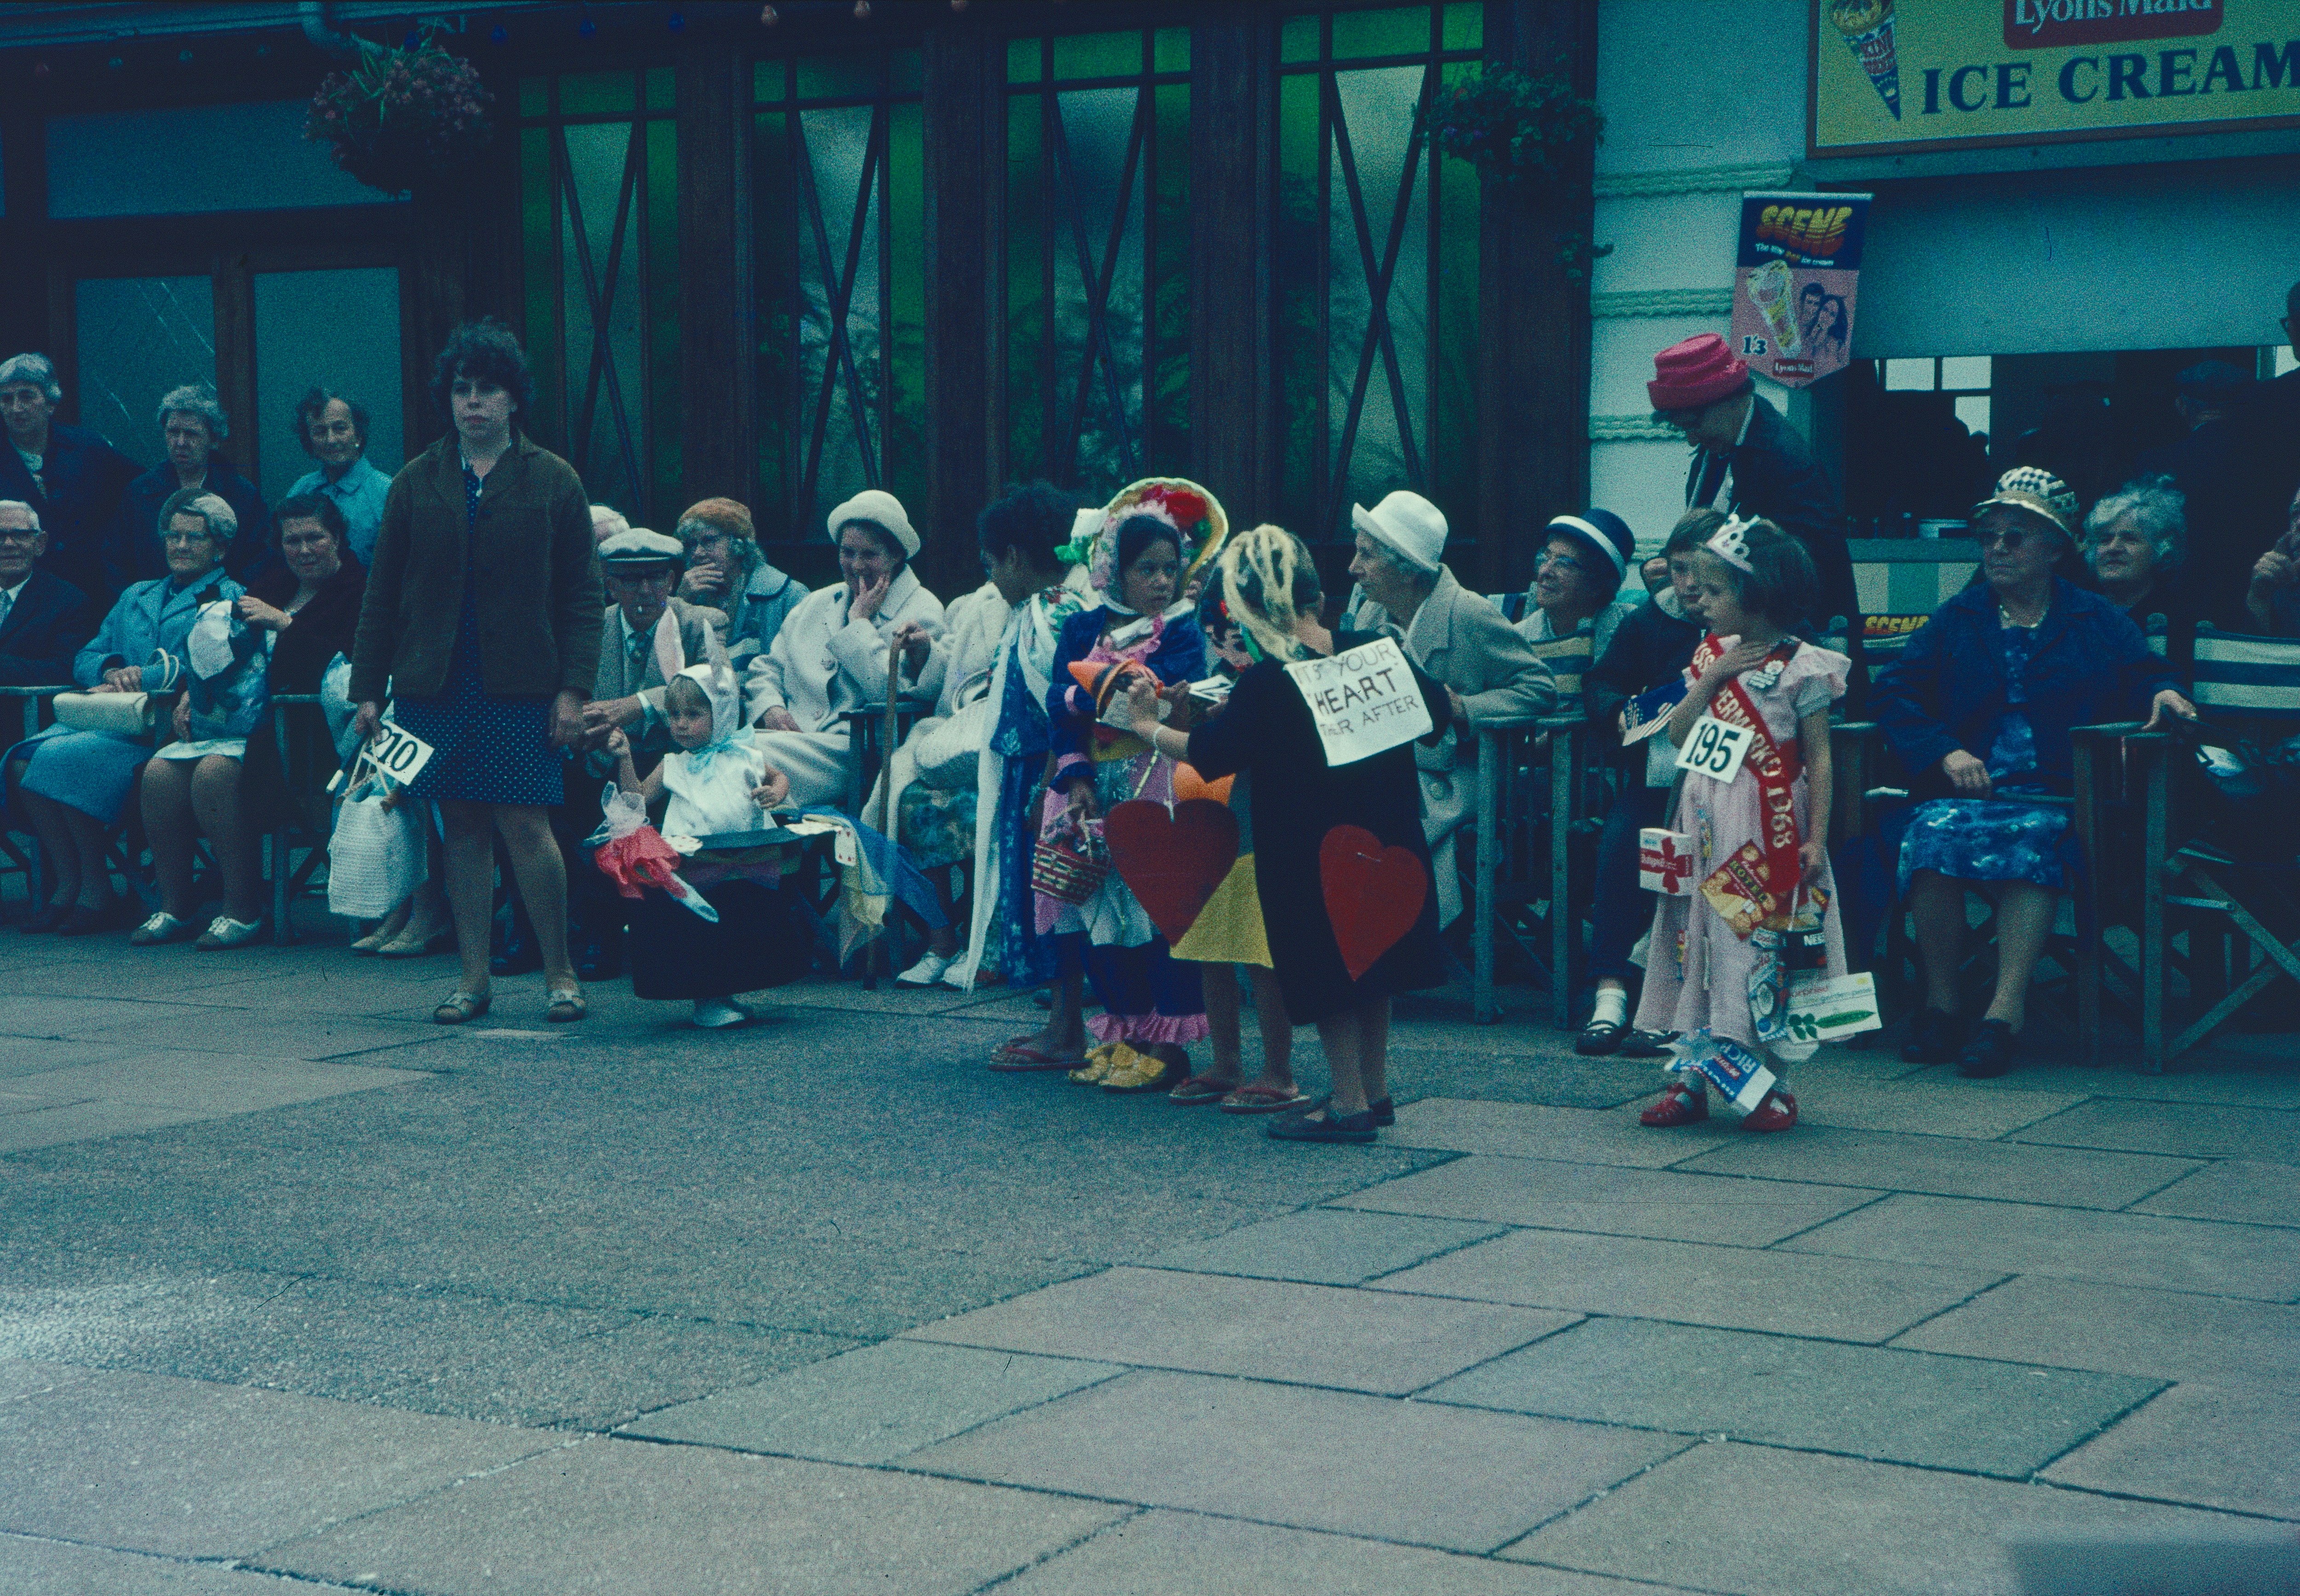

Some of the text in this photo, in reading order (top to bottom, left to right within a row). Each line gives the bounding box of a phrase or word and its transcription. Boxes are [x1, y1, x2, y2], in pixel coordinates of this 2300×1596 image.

[1922, 40, 2300, 115] ICE CREAM
[1757, 205, 1853, 248] SCENE
[1330, 643, 1396, 677] YOUR
[1314, 667, 1396, 716] HEART
[1362, 695, 1419, 726] AFTER
[1685, 722, 1741, 773] 195
